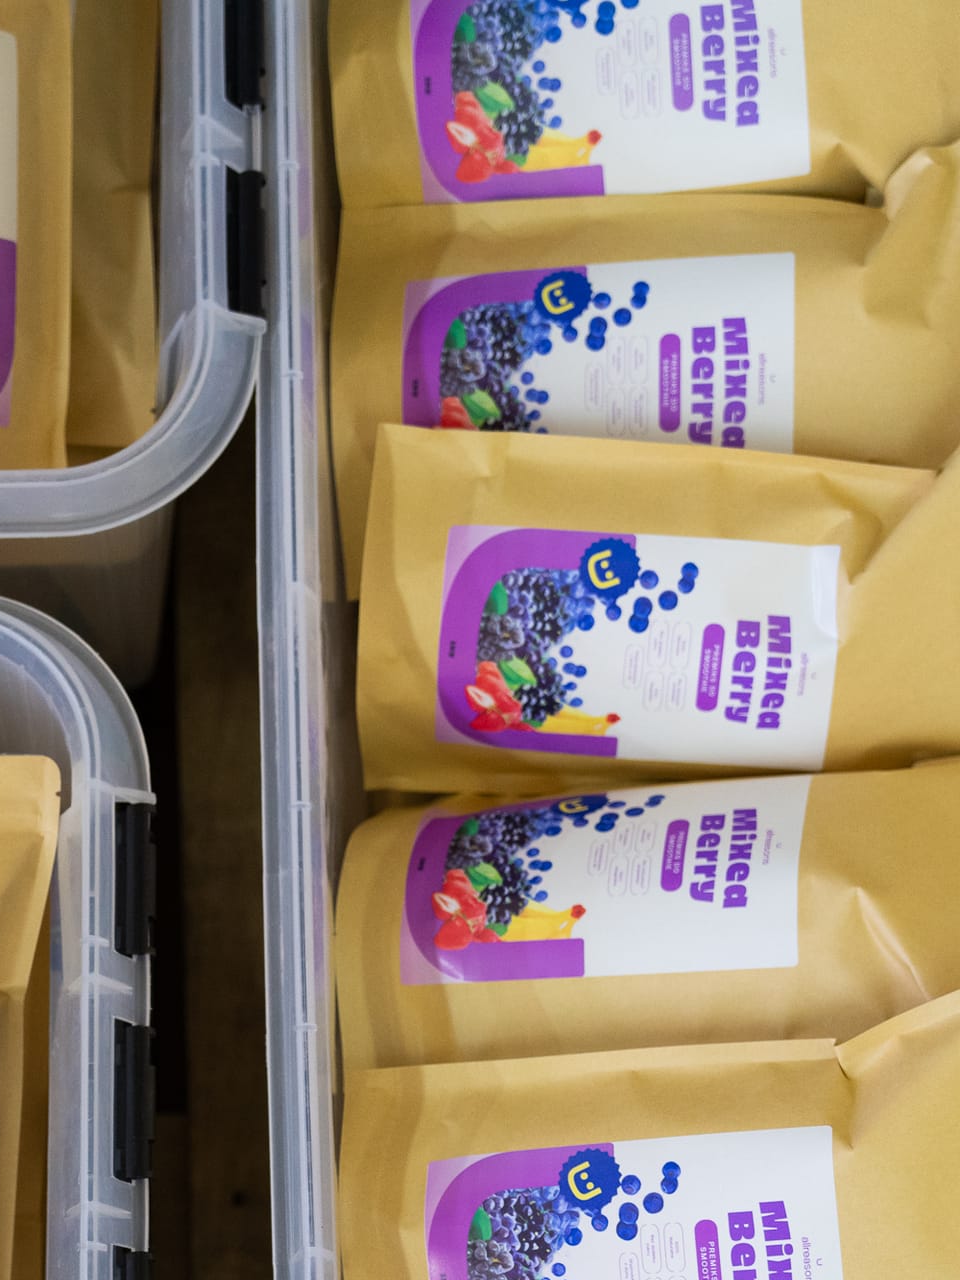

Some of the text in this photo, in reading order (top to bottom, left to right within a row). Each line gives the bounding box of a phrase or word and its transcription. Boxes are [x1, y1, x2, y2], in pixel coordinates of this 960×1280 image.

[700, 4, 726, 121] Berry
[730, 0, 760, 127] Mixed
[688, 326, 716, 445] Berry
[721, 317, 750, 449] Mixed
[724, 620, 761, 724] Berry
[756, 615, 792, 730] Mixed
[689, 814, 726, 903] Berry
[722, 808, 758, 909] Mixed
